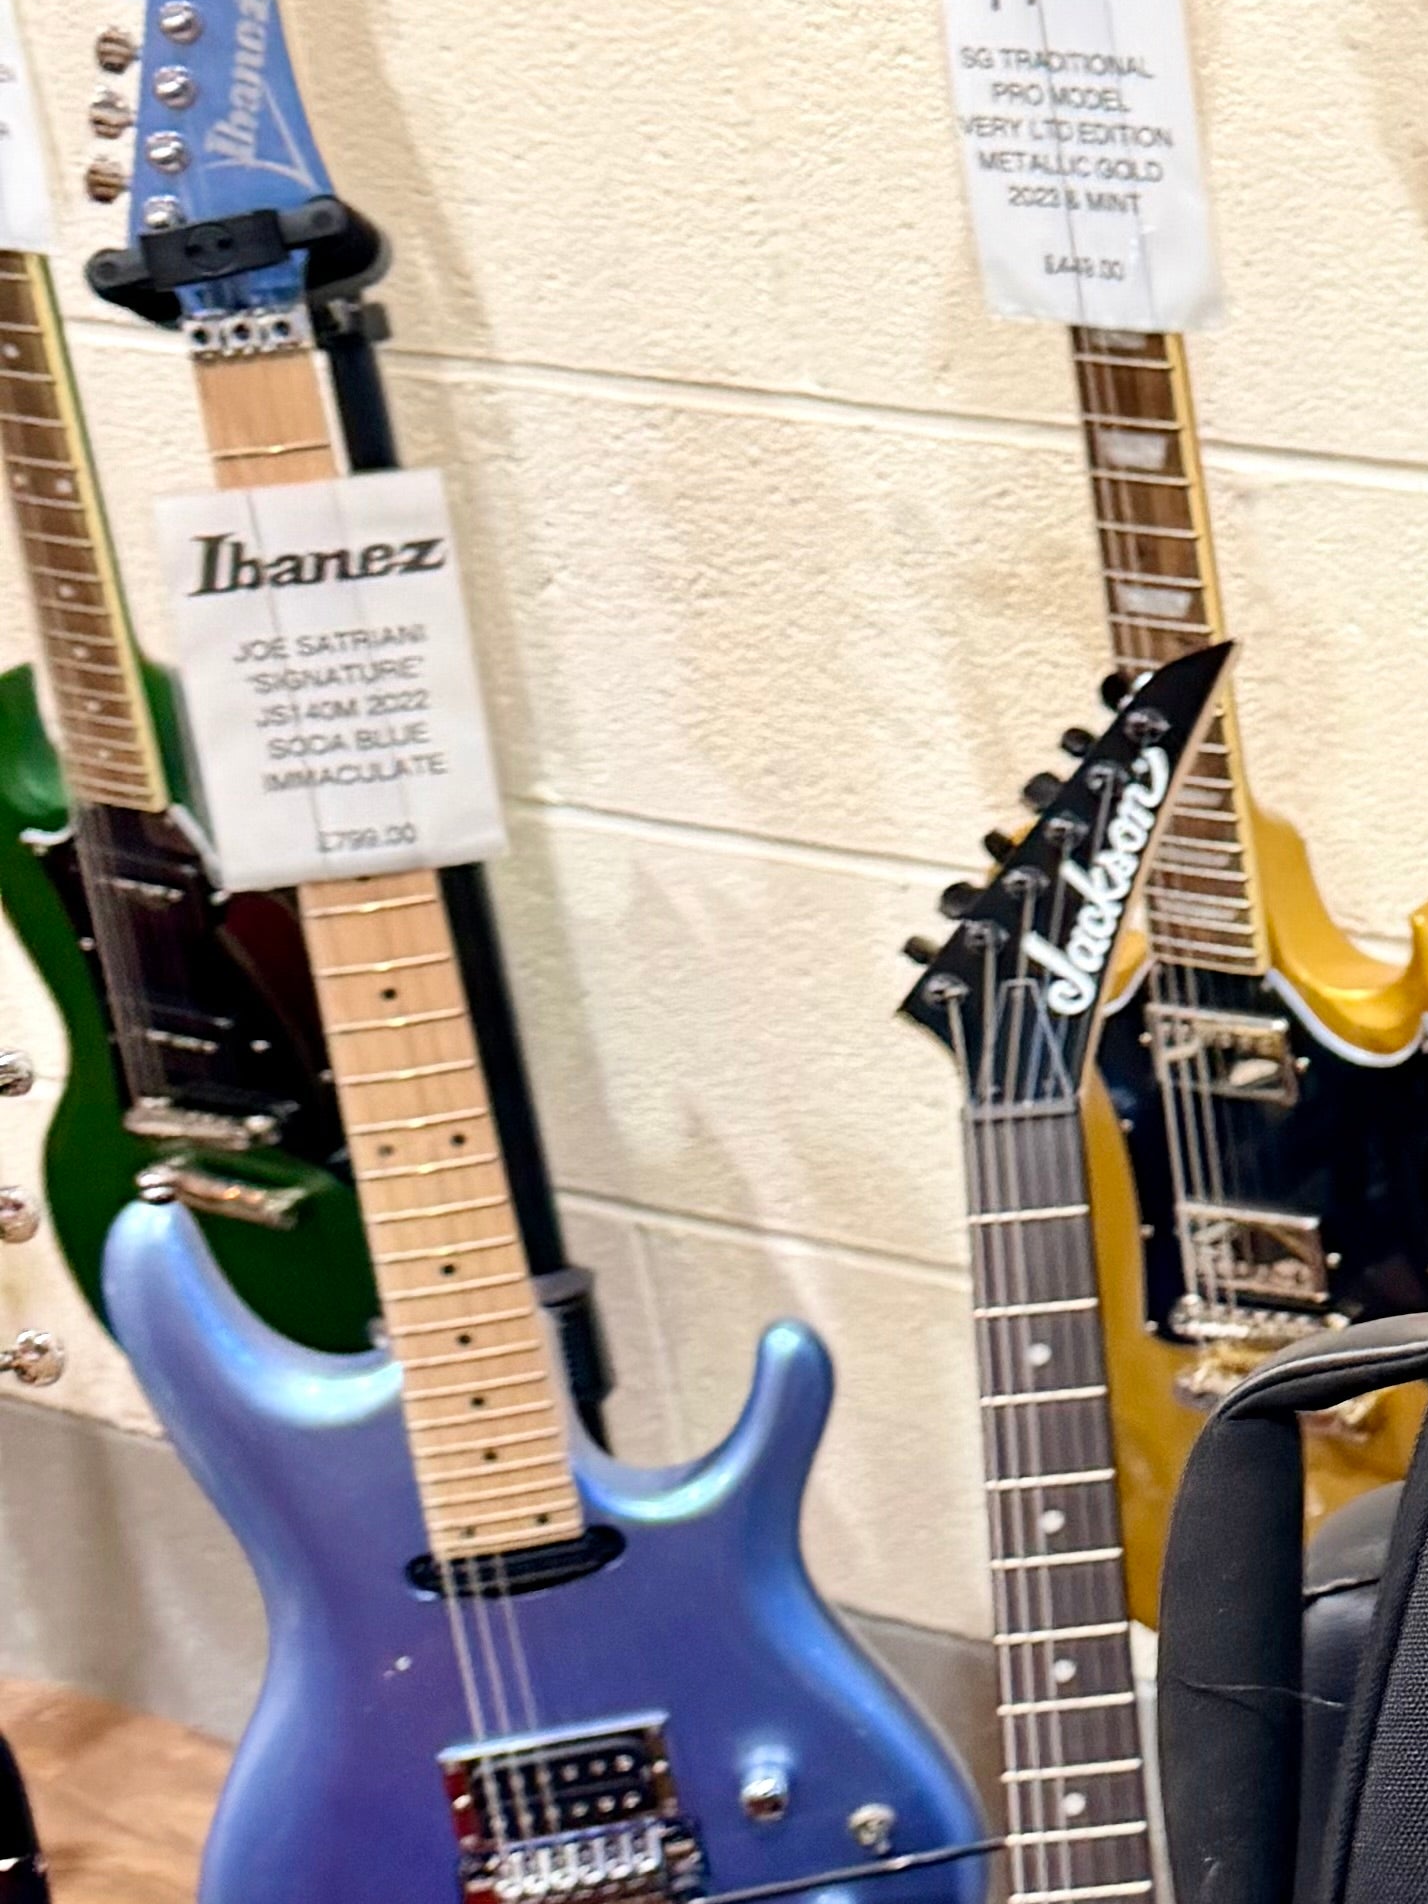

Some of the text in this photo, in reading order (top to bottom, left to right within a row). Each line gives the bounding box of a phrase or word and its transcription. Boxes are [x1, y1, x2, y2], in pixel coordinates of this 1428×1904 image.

[960, 47, 1155, 79] SG TRADITIONAL
[992, 82, 1131, 113] PRO MODEL
[960, 115, 1174, 148] VERY LTD EDITION
[978, 150, 1163, 182] METALLIC GOLD
[1086, 192, 1142, 215] MINT
[187, 533, 446, 596] Ibanez
[233, 626, 427, 662] JOE SATRIANI
[366, 689, 430, 716] 2022
[355, 721, 431, 751] BLUE
[263, 752, 448, 792] IMMACULATE
[1024, 746, 1170, 1014] Jackson
